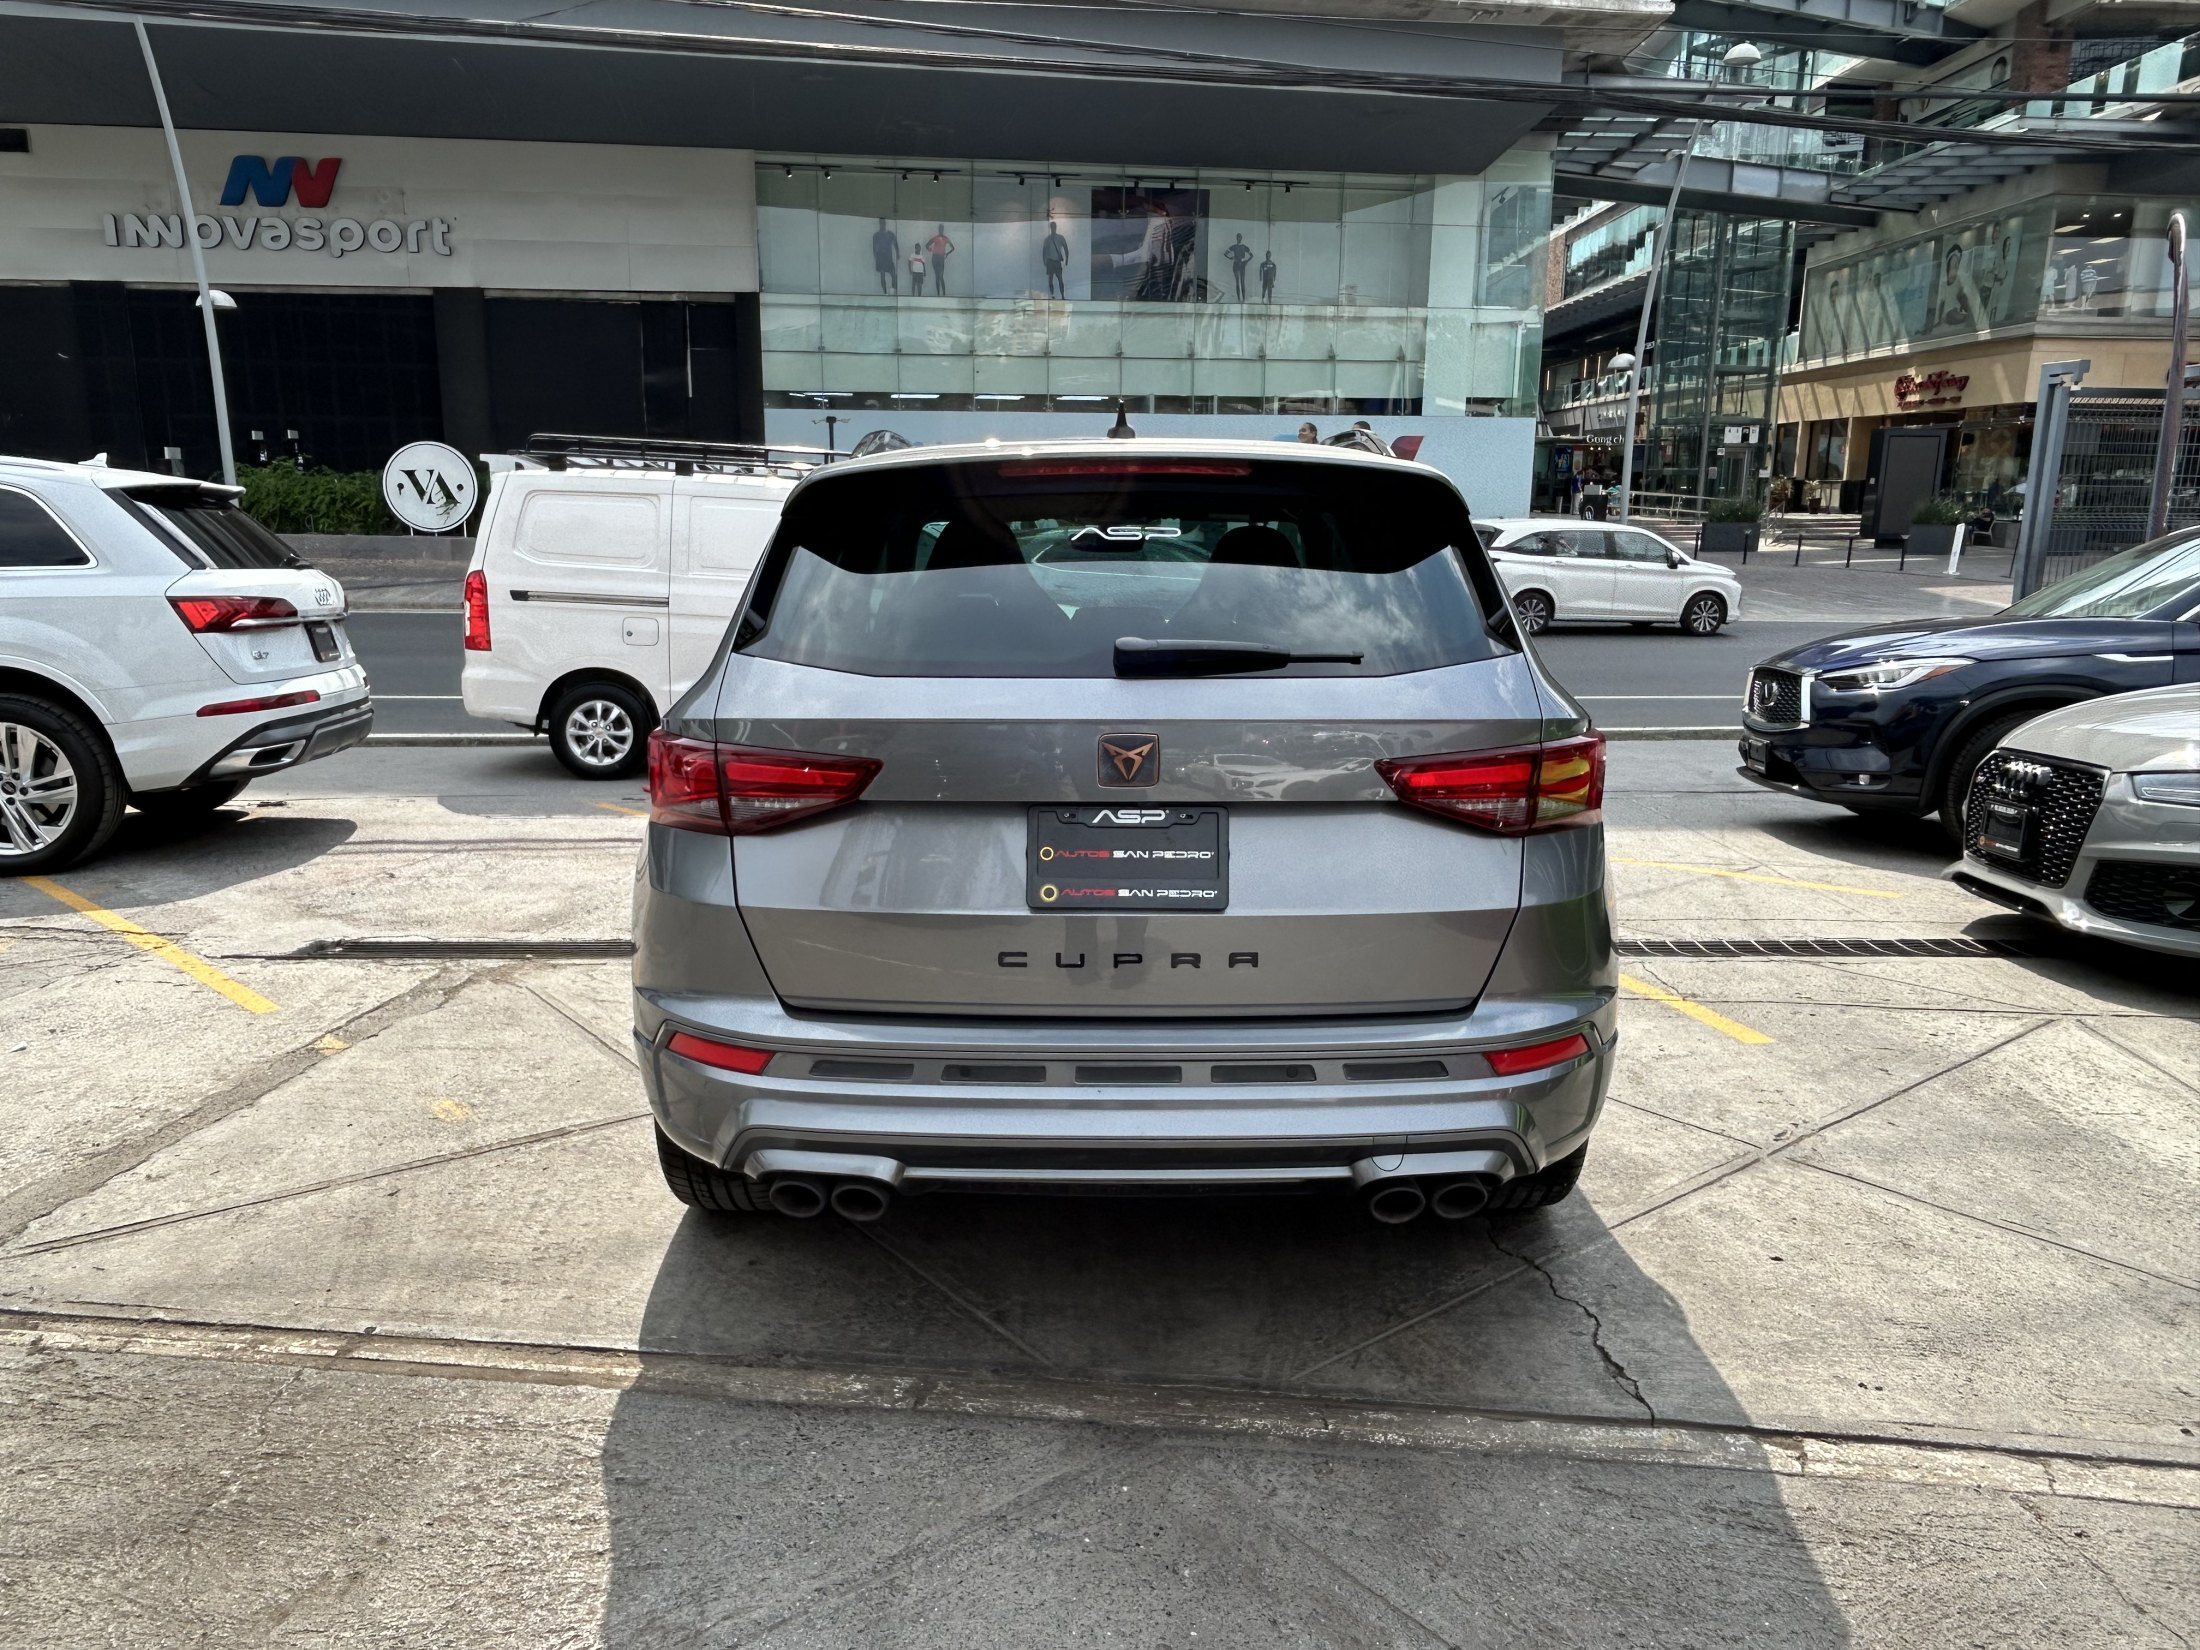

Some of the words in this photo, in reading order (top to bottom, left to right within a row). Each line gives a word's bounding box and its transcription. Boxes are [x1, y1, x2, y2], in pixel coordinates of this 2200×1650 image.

[1586, 434, 1612, 446] Gong
[1613, 434, 1626, 444] ch
[1071, 526, 1181, 541] ASP
[1092, 809, 1166, 824] ASP
[1055, 850, 1111, 858] AUTOS
[1113, 850, 1149, 858] SAN
[1152, 851, 1212, 859] PEDRO
[1060, 888, 1116, 896] AUTOS
[1118, 888, 1154, 897] SAN
[1157, 889, 1215, 898] PEDRO
[998, 951, 1258, 968] CUPRA
